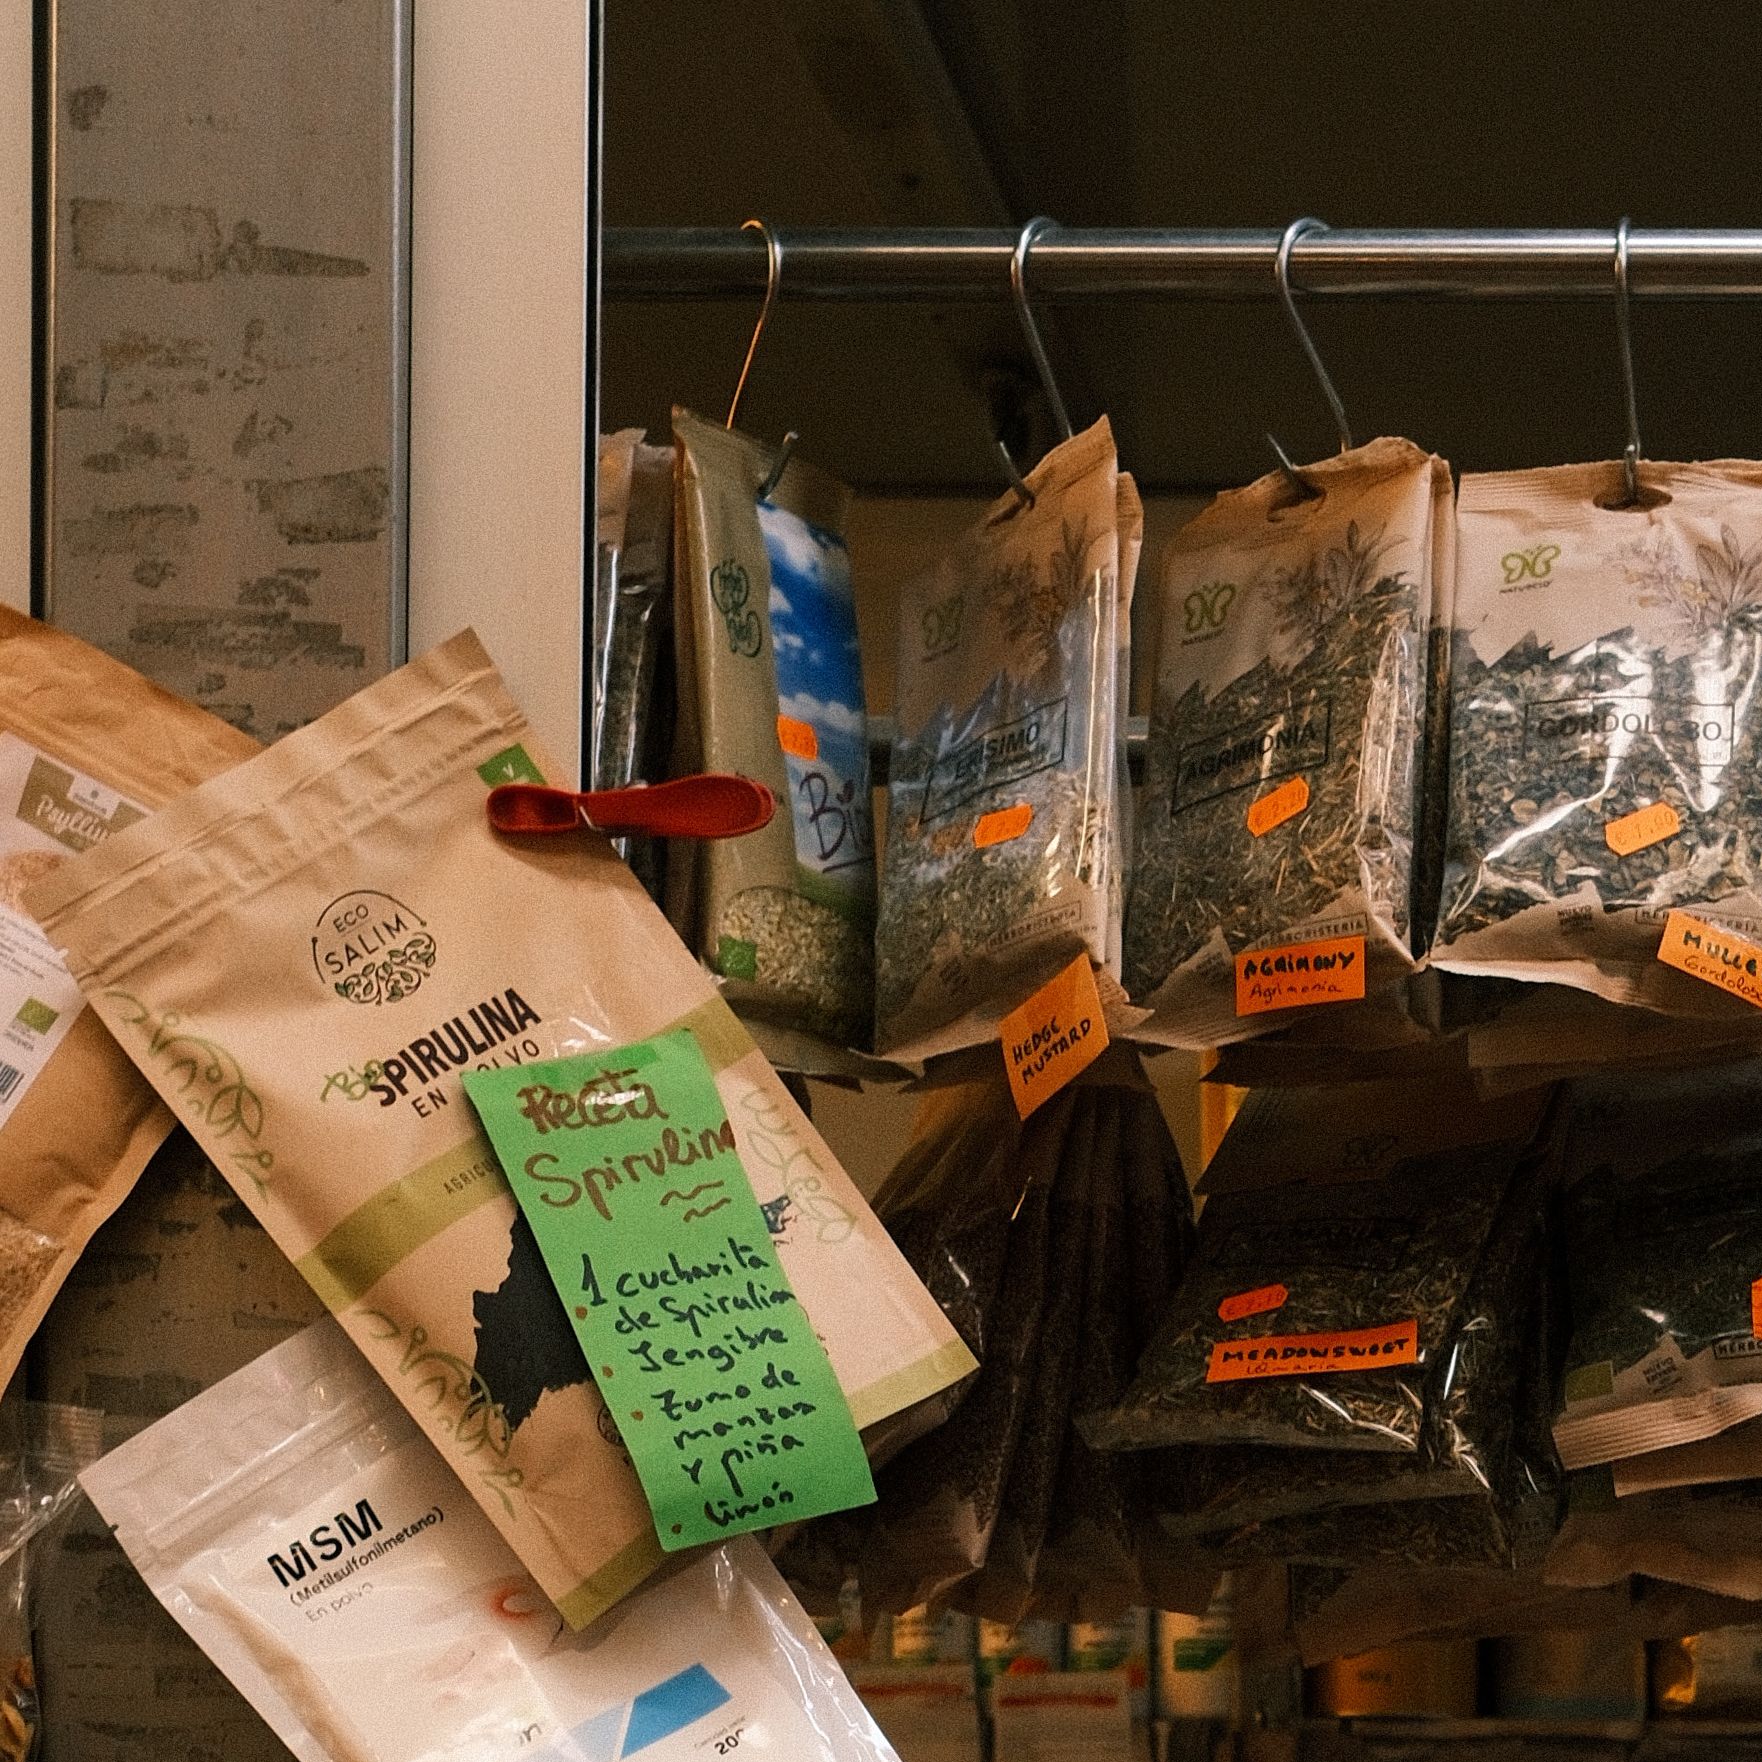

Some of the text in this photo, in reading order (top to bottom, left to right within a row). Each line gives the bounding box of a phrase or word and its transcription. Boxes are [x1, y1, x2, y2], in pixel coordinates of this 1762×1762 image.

[323, 912, 408, 976] SALIM
[332, 902, 371, 935] ECO
[368, 986, 543, 1108] SPIRULINA
[1021, 1018, 1092, 1085] MUSTARD
[411, 1086, 449, 1119] EN
[516, 1068, 670, 1135] Receta
[580, 1252, 608, 1308] 1
[613, 1305, 660, 1335] de
[761, 1362, 801, 1390] de
[266, 1498, 384, 1589] MSM
